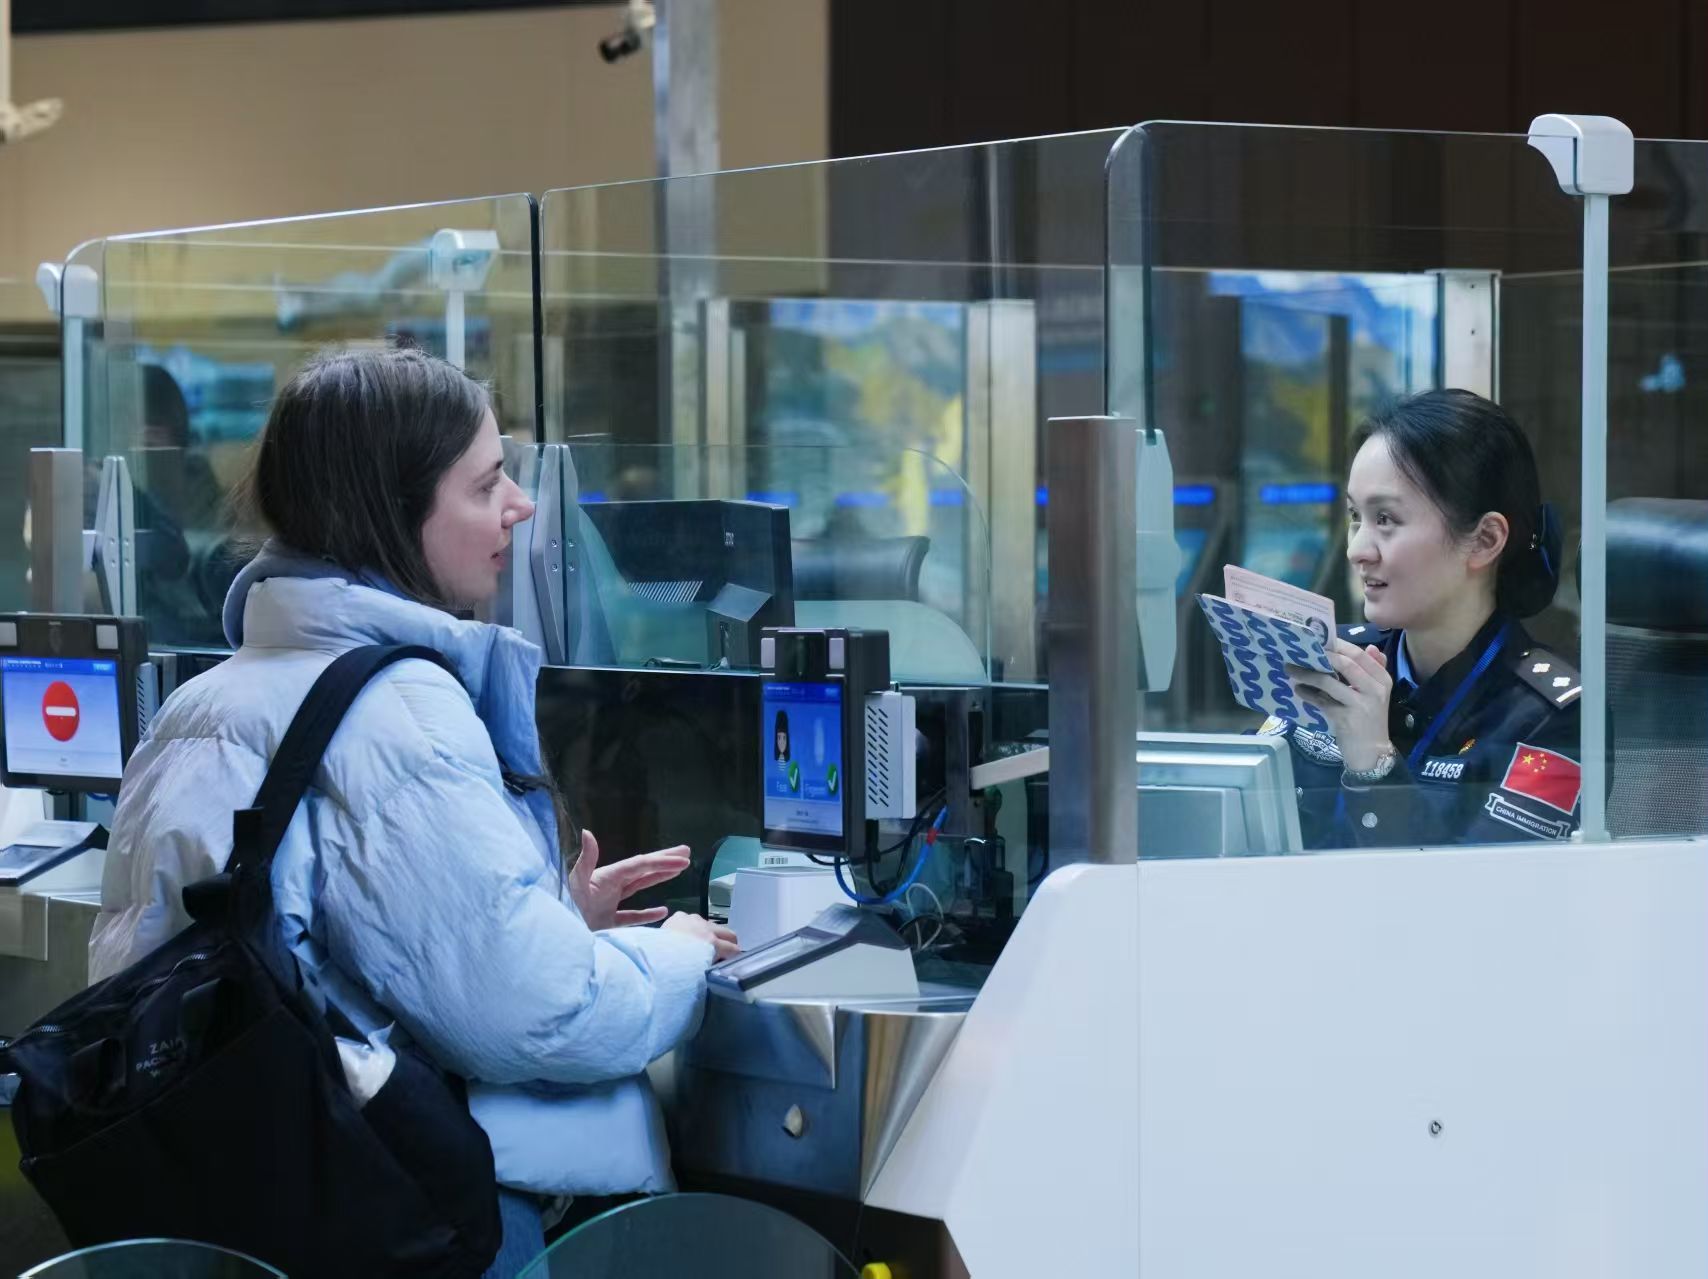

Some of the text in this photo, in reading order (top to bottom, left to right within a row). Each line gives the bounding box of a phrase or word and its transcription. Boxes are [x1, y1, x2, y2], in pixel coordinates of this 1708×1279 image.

[1421, 760, 1465, 779] 118458
[1496, 806, 1557, 836] CHINA IMMIGRATION
